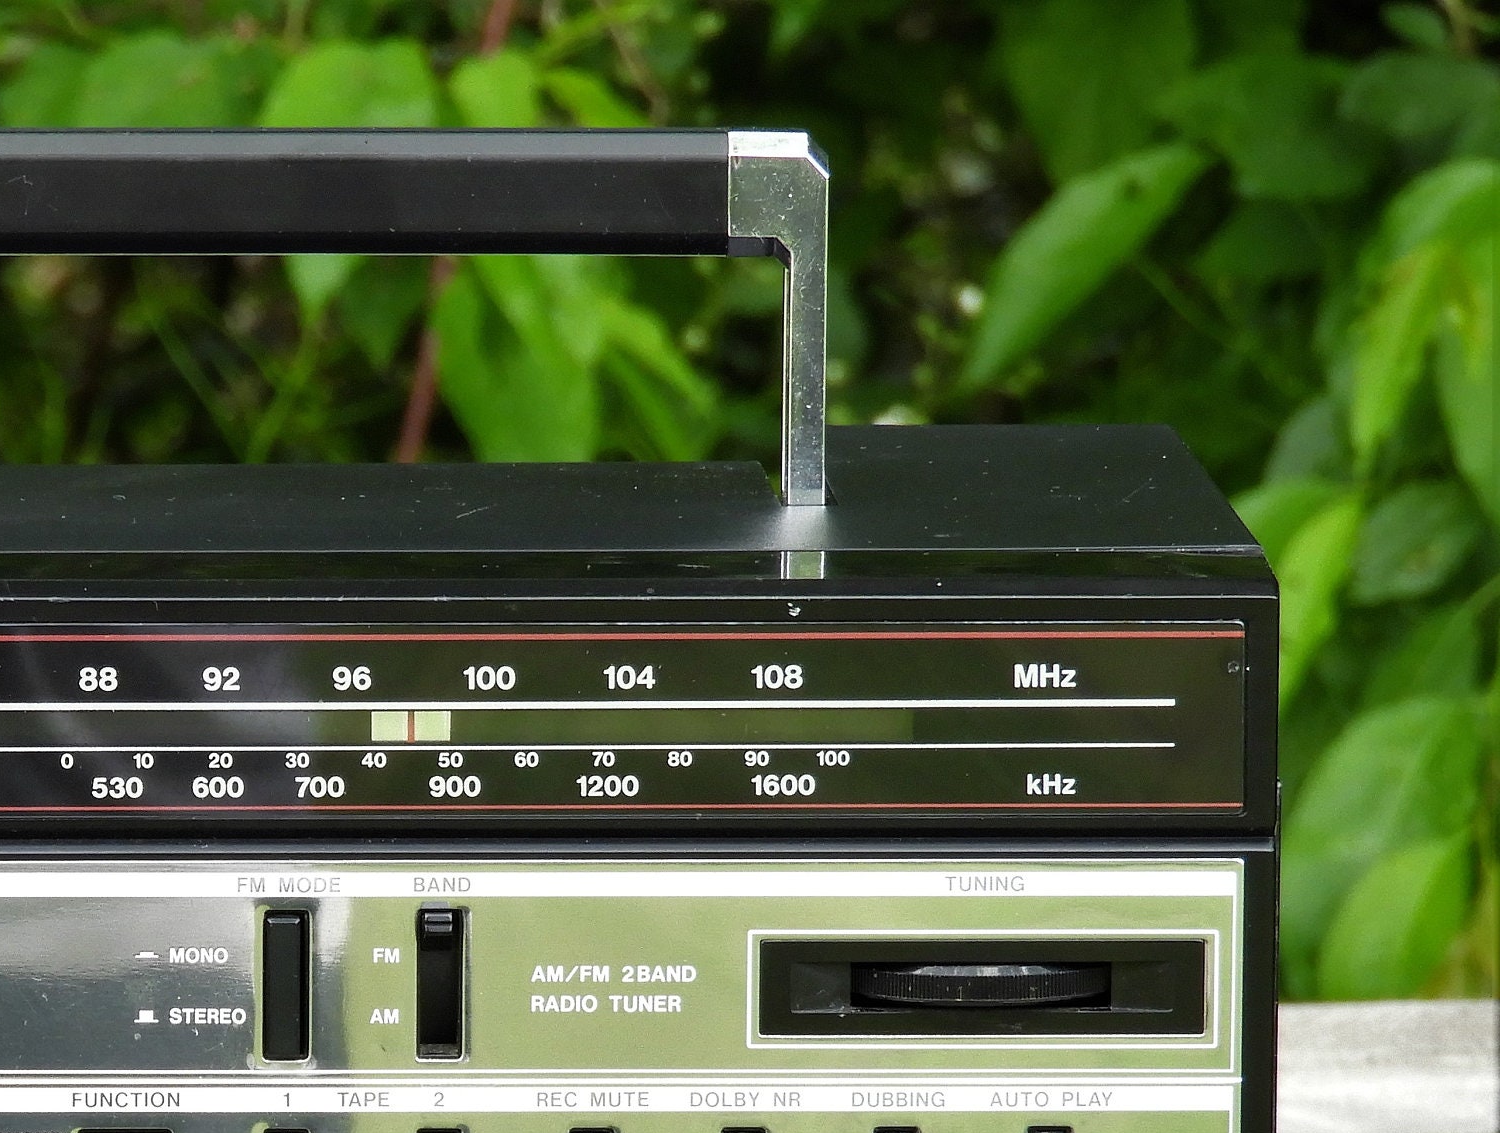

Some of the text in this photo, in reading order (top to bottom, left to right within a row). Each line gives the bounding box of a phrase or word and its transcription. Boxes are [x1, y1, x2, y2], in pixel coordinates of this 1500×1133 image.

[79, 667, 117, 691] 88
[203, 667, 240, 691] 92
[333, 667, 371, 690] 96
[463, 666, 515, 690] 100
[604, 666, 655, 689] 104
[751, 665, 803, 689] 108
[1015, 664, 1076, 687] MHz
[61, 751, 850, 769] 0 10 20 30 40 50 60 70 80 90 100
[92, 777, 143, 798] 530
[193, 777, 244, 798] 600
[295, 776, 344, 797] 700
[429, 776, 481, 797] 900
[577, 775, 639, 796] 1200
[751, 775, 815, 796] 1600
[1027, 774, 1076, 794] kHz
[238, 878, 340, 893] FM MODE
[414, 878, 470, 892] BAND
[945, 876, 1024, 891] TUNING
[170, 948, 228, 963] MONO
[374, 948, 399, 963] FM
[531, 966, 696, 982] AM/FM 2BAND
[532, 995, 681, 1012] RADIO TUNER
[170, 1008, 246, 1024] STEREO
[370, 1009, 399, 1024] AM
[73, 1092, 179, 1107] FUNCTION
[284, 1092, 444, 1106] 1 TAPE 2
[538, 1092, 648, 1107] REC MUTE
[691, 1092, 800, 1107] DOLBY NR
[852, 1092, 944, 1107] DUBBING
[991, 1092, 1112, 1107] AUTO PLAY
